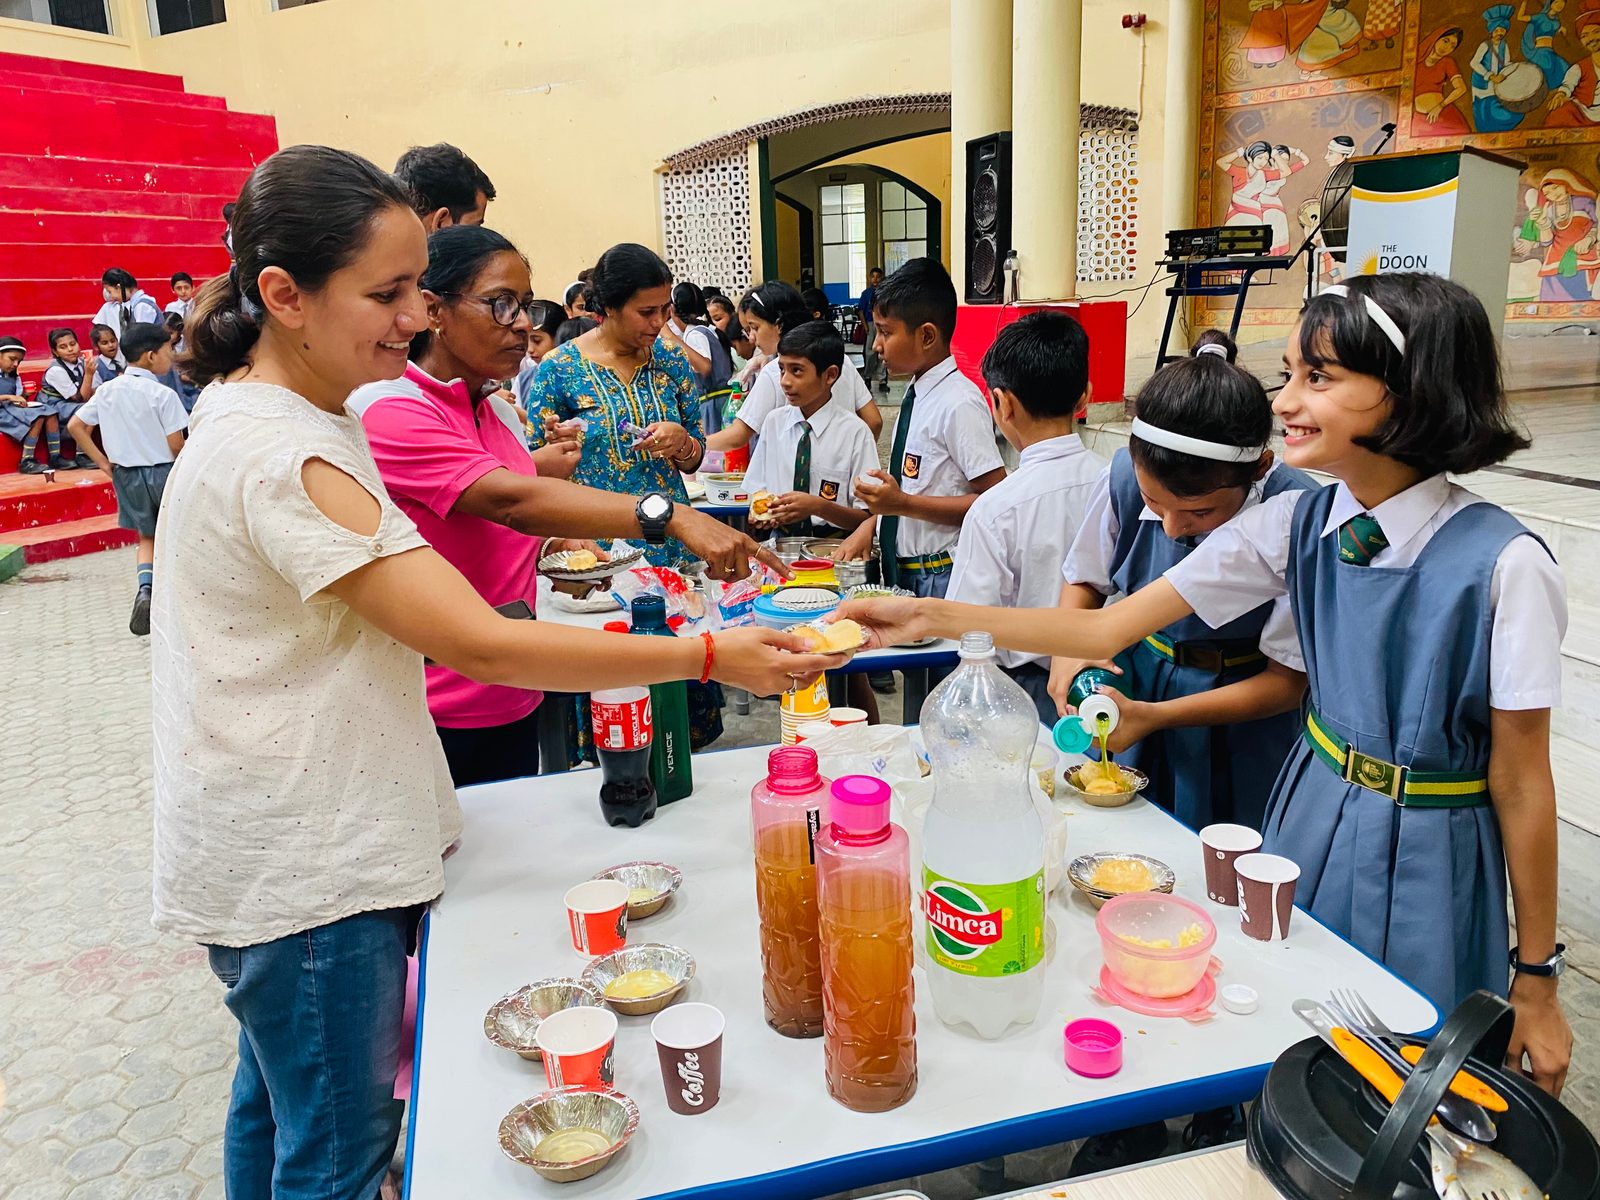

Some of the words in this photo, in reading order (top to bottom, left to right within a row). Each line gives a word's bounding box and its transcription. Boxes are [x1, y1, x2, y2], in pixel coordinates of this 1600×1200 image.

[1380, 255, 1427, 269] DOON
[631, 702, 637, 714] ME
[666, 732, 674, 773] VENICE
[926, 896, 997, 936] Limca
[678, 1052, 705, 1106] Coffee
